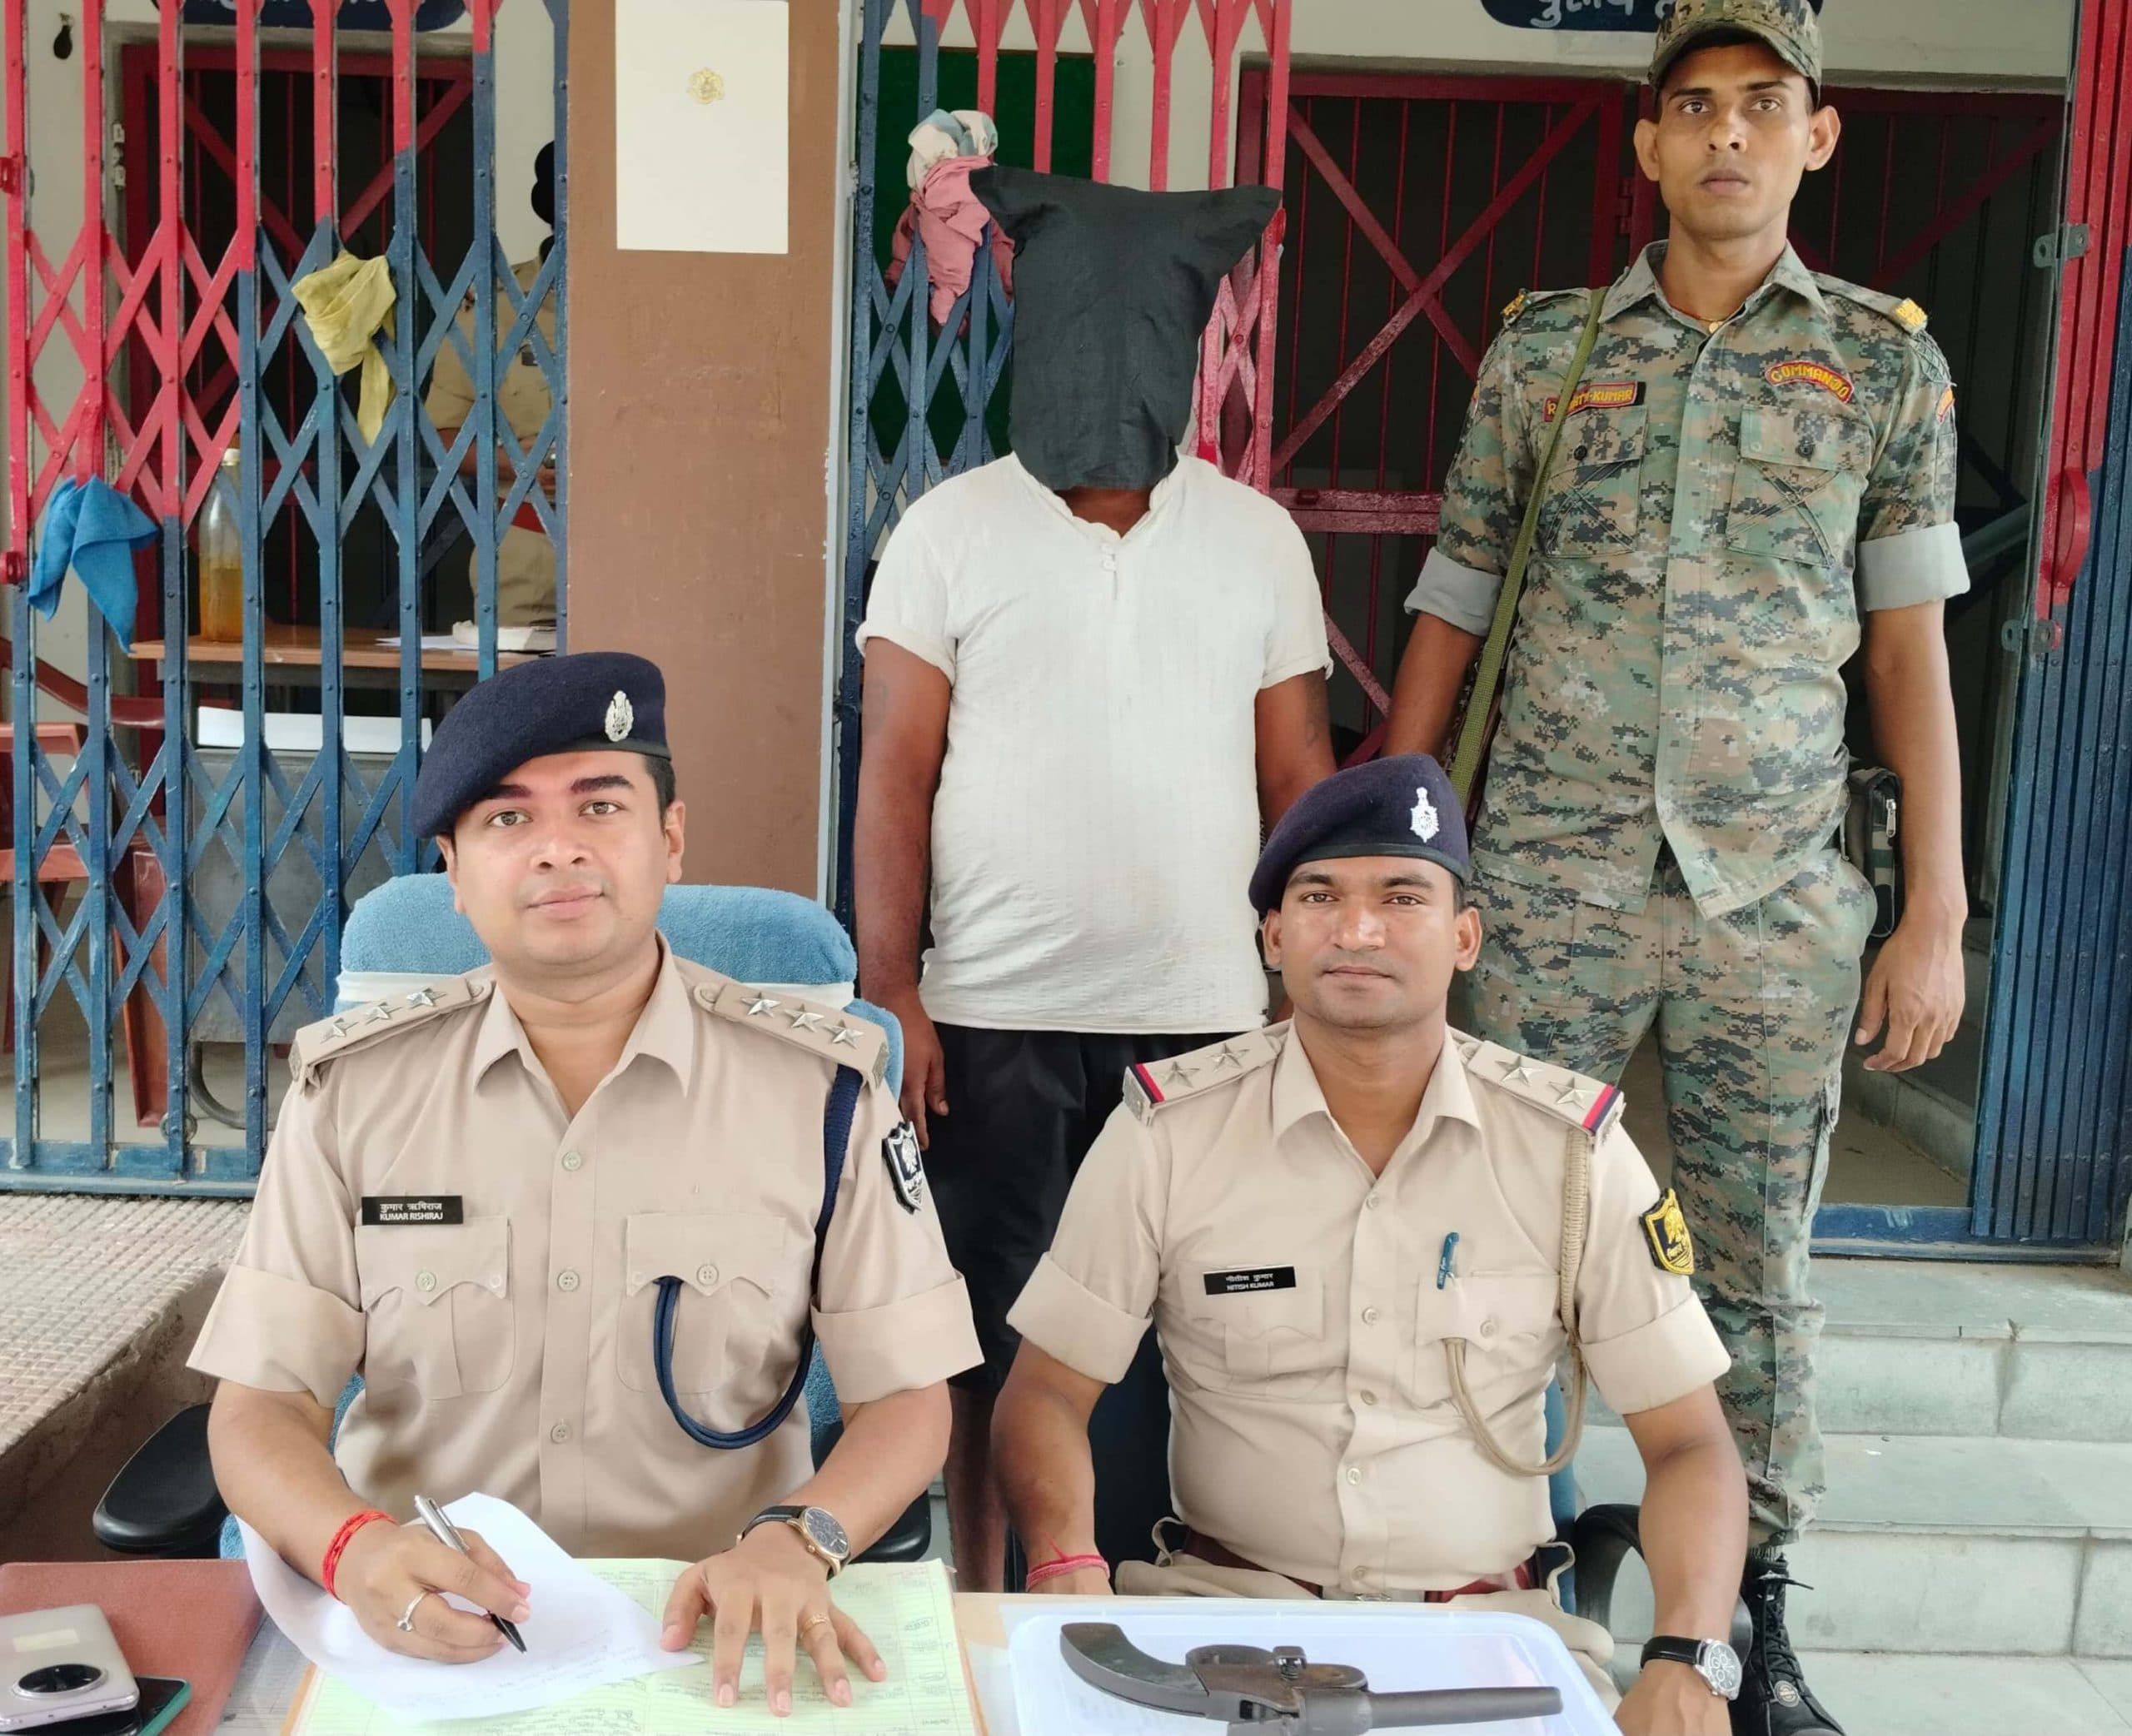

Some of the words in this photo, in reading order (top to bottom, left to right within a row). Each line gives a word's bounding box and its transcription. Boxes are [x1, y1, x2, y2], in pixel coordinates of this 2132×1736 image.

[1771, 364, 1849, 397] COMMANDO
[380, 1202, 403, 1213] कुमार
[380, 1212, 408, 1221] KUMAR
[410, 1211, 443, 1220] RISHIRAJ
